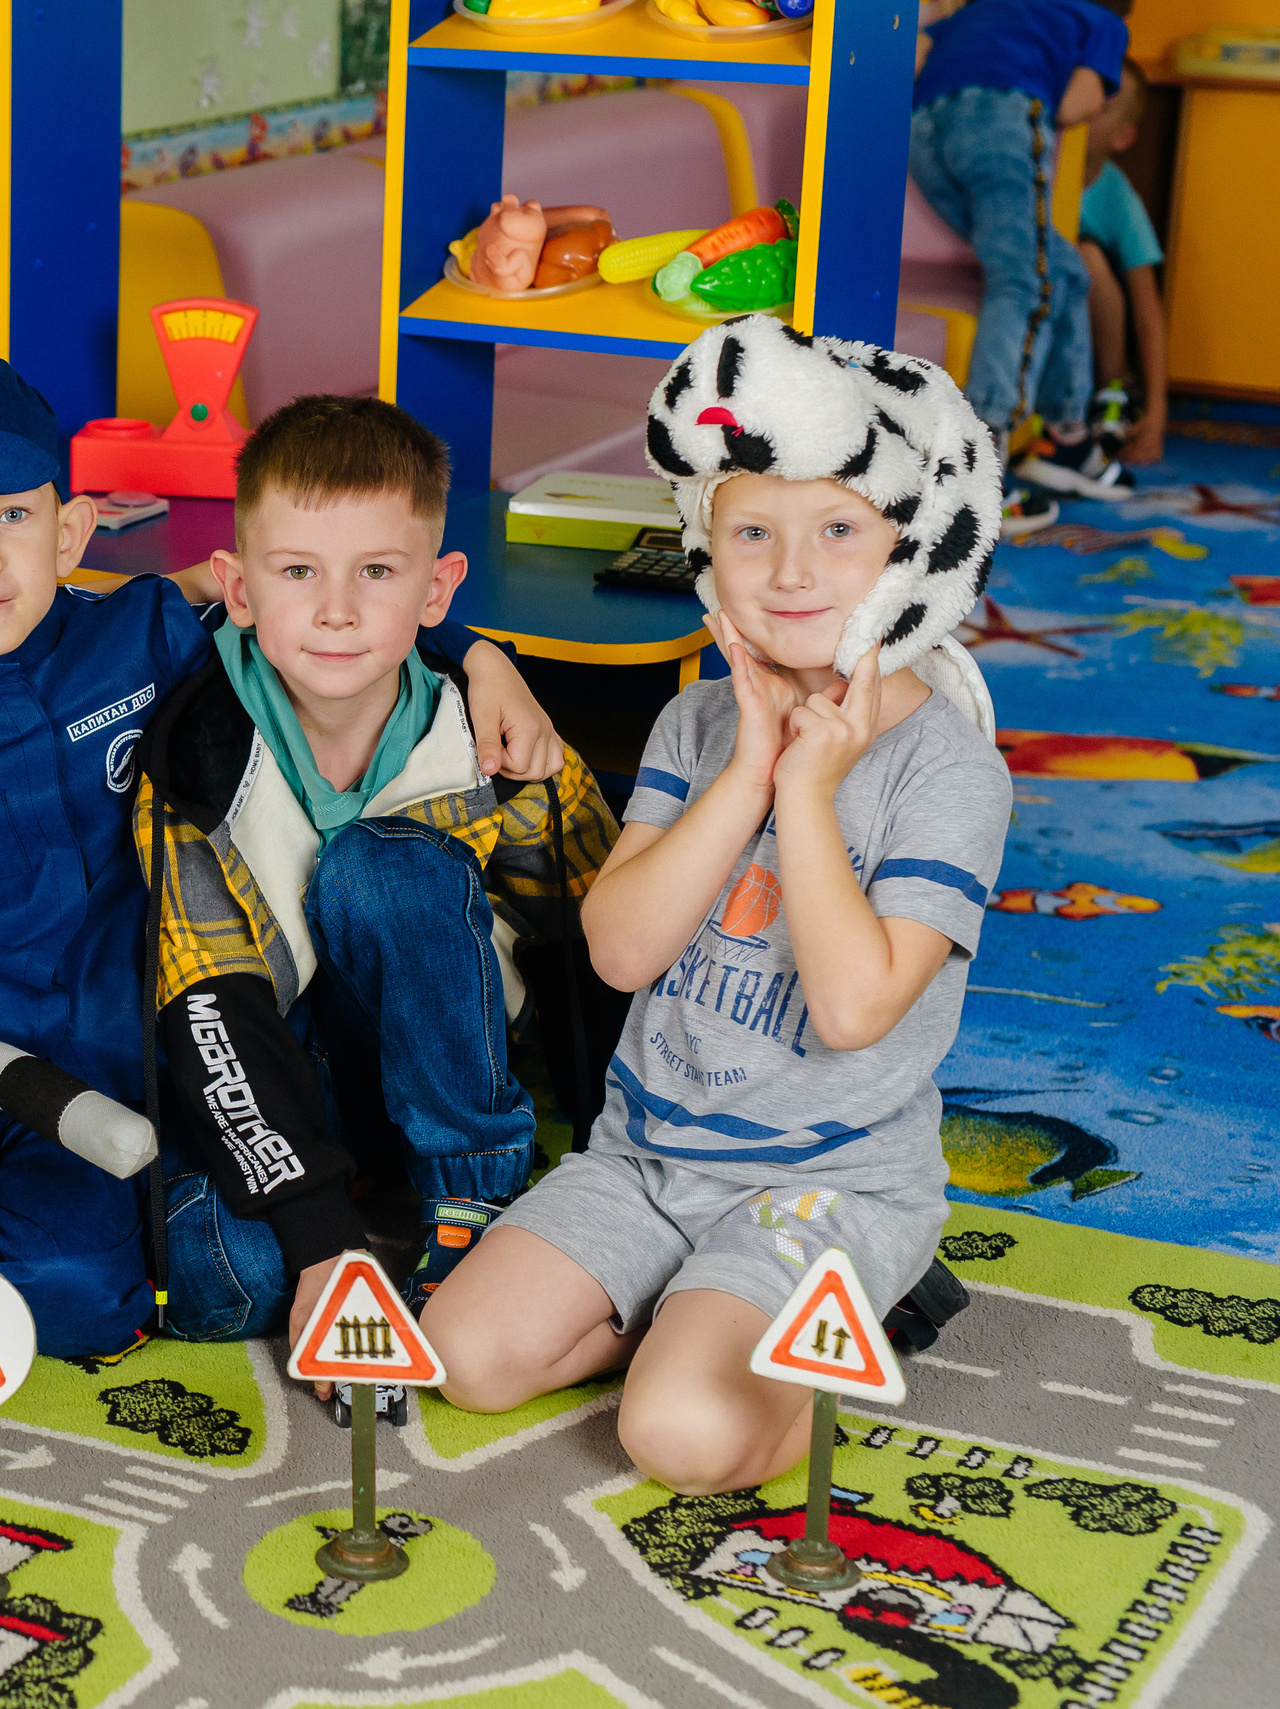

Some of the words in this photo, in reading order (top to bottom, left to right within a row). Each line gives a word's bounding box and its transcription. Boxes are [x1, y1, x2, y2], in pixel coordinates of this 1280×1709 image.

[72, 703, 129, 737] КАПИТАН
[131, 689, 152, 710] ДПС
[249, 758, 259, 775] HOME
[649, 1031, 685, 1073] STREET
[707, 1066, 747, 1087] TEAM
[187, 993, 305, 1194] MGBROTHER
[204, 1095, 219, 1110] WE
[211, 1110, 229, 1130] ARE
[221, 1135, 235, 1150] WE
[243, 1172, 260, 1194] WIN
[224, 1127, 269, 1184] HURRICANES
